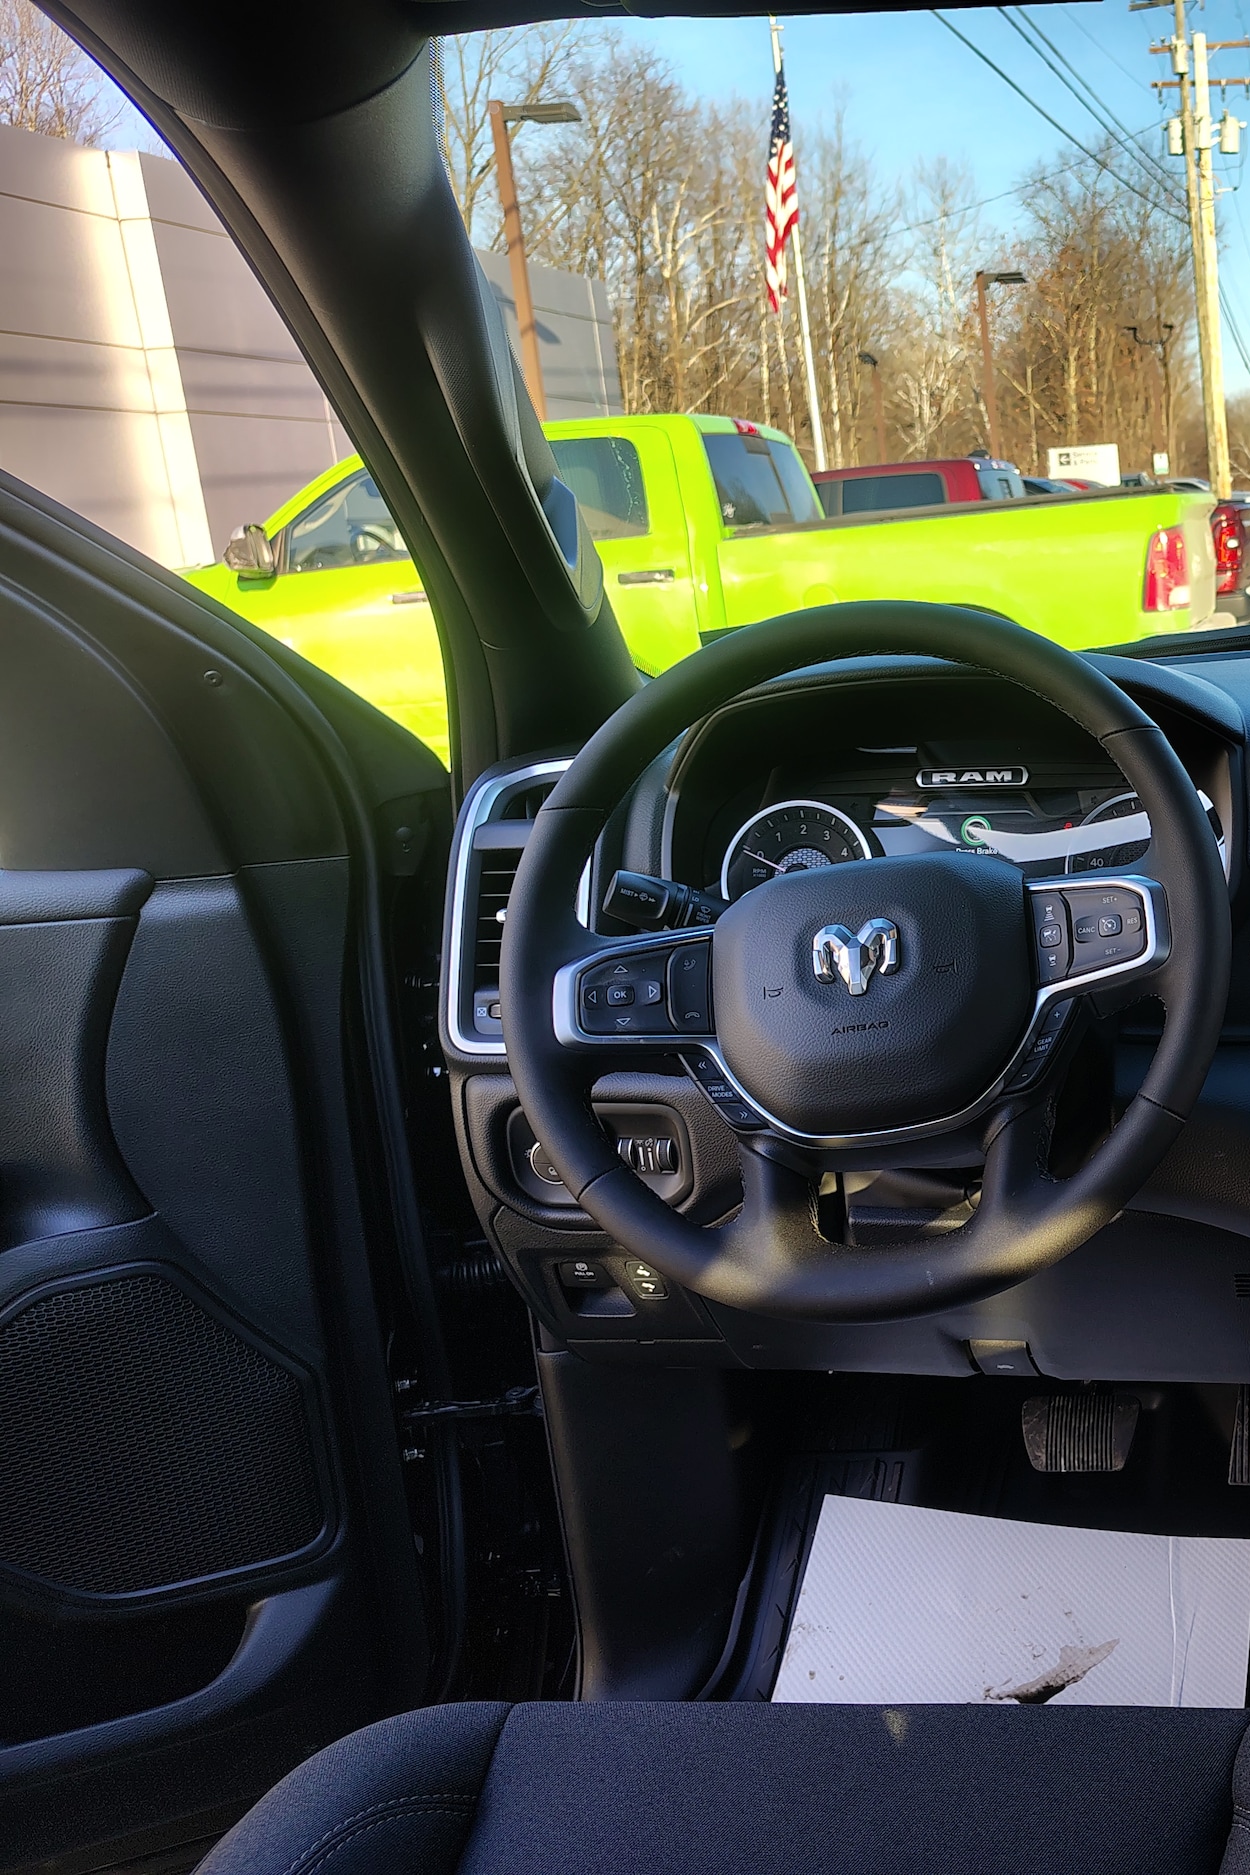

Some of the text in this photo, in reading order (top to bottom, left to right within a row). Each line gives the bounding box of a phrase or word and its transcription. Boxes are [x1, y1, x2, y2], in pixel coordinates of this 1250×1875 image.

[931, 770, 1012, 783] RAM
[800, 824, 807, 834] 2
[775, 832, 781, 841] 1
[823, 831, 830, 840] 3
[841, 848, 848, 856] 4
[976, 847, 998, 855] Brake
[1090, 858, 1104, 867] 40
[620, 888, 634, 897] MIST
[1127, 917, 1138, 925] RES
[1077, 926, 1096, 934] CANC
[614, 990, 627, 999] OK
[831, 1020, 890, 1036] AIRBAG
[1037, 1037, 1053, 1046] GEAR
[1034, 1044, 1049, 1053] LIMIT
